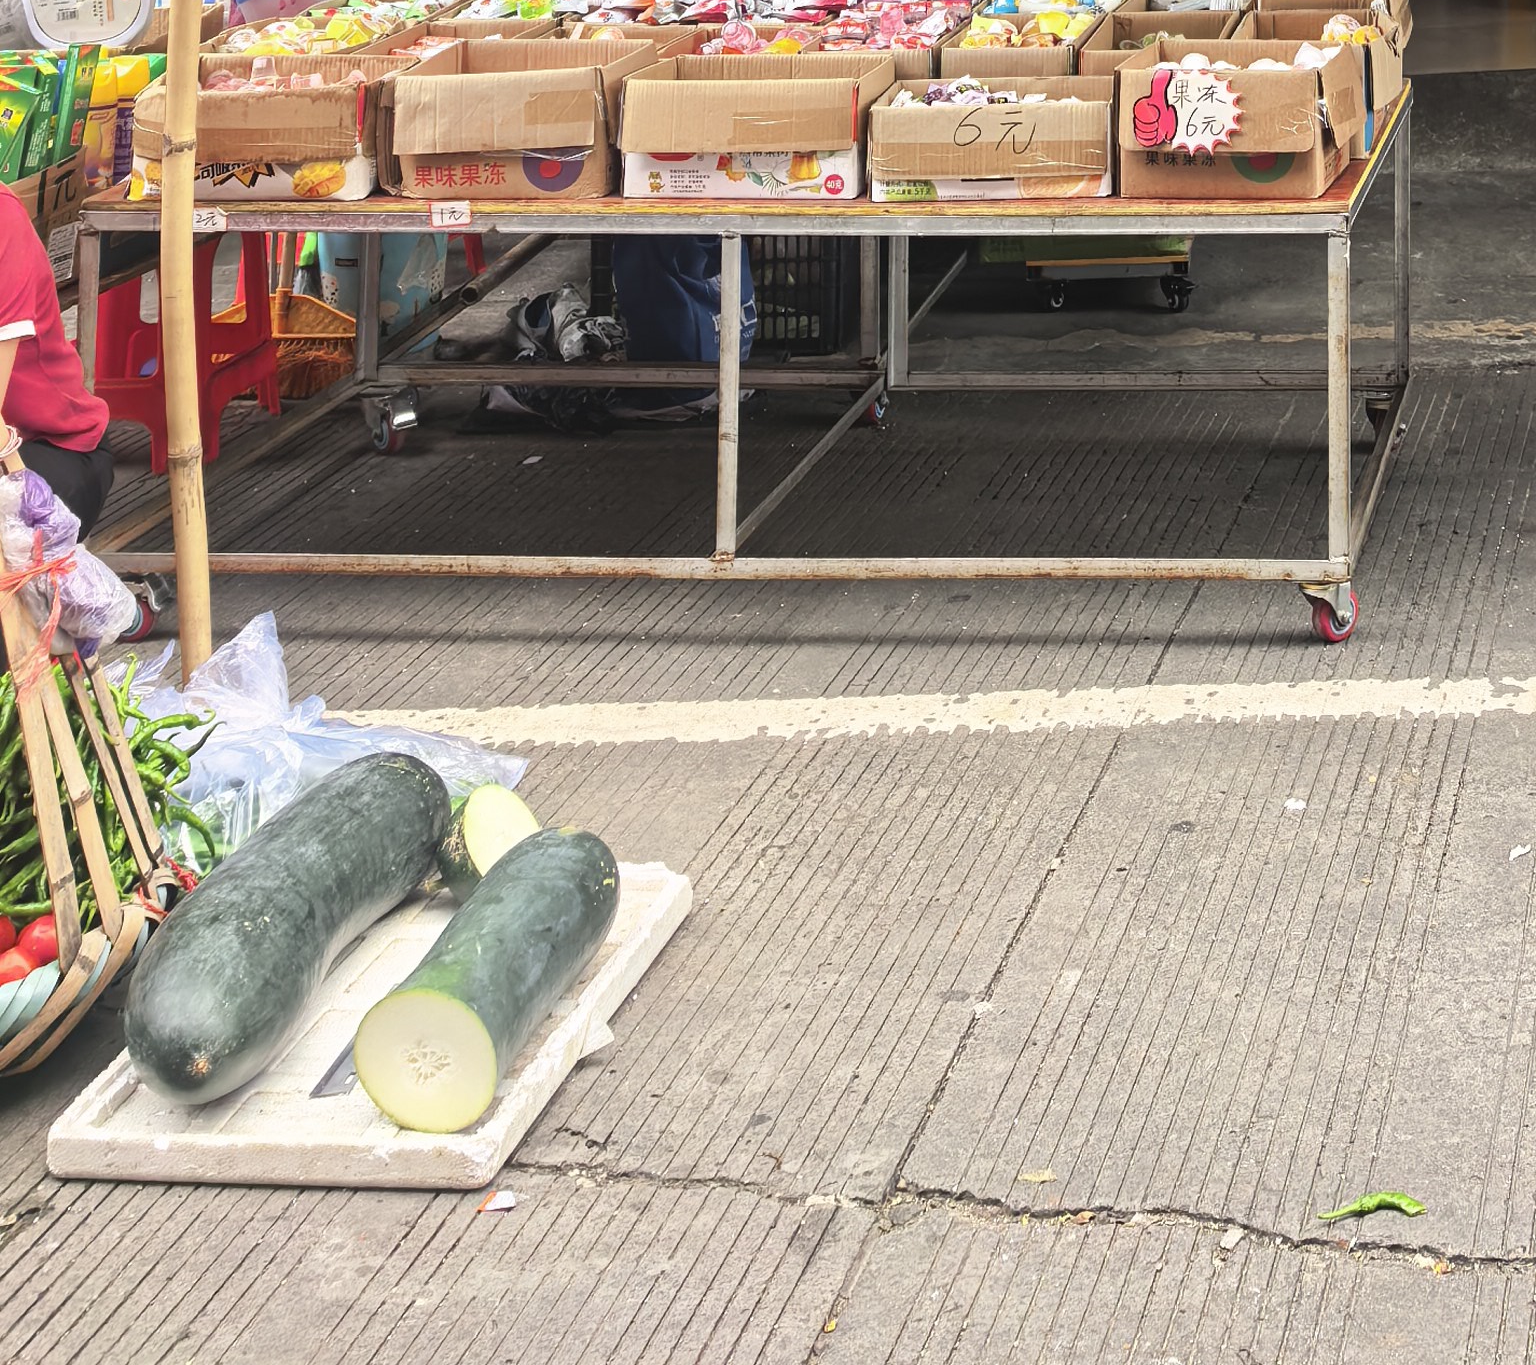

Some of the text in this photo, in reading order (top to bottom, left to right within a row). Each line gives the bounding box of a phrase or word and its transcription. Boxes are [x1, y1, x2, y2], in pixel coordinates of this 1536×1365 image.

[1172, 78, 1227, 105] 果冻
[953, 106, 1037, 155] 6元
[1184, 106, 1226, 138] 6元
[413, 162, 507, 190] 果味果冻
